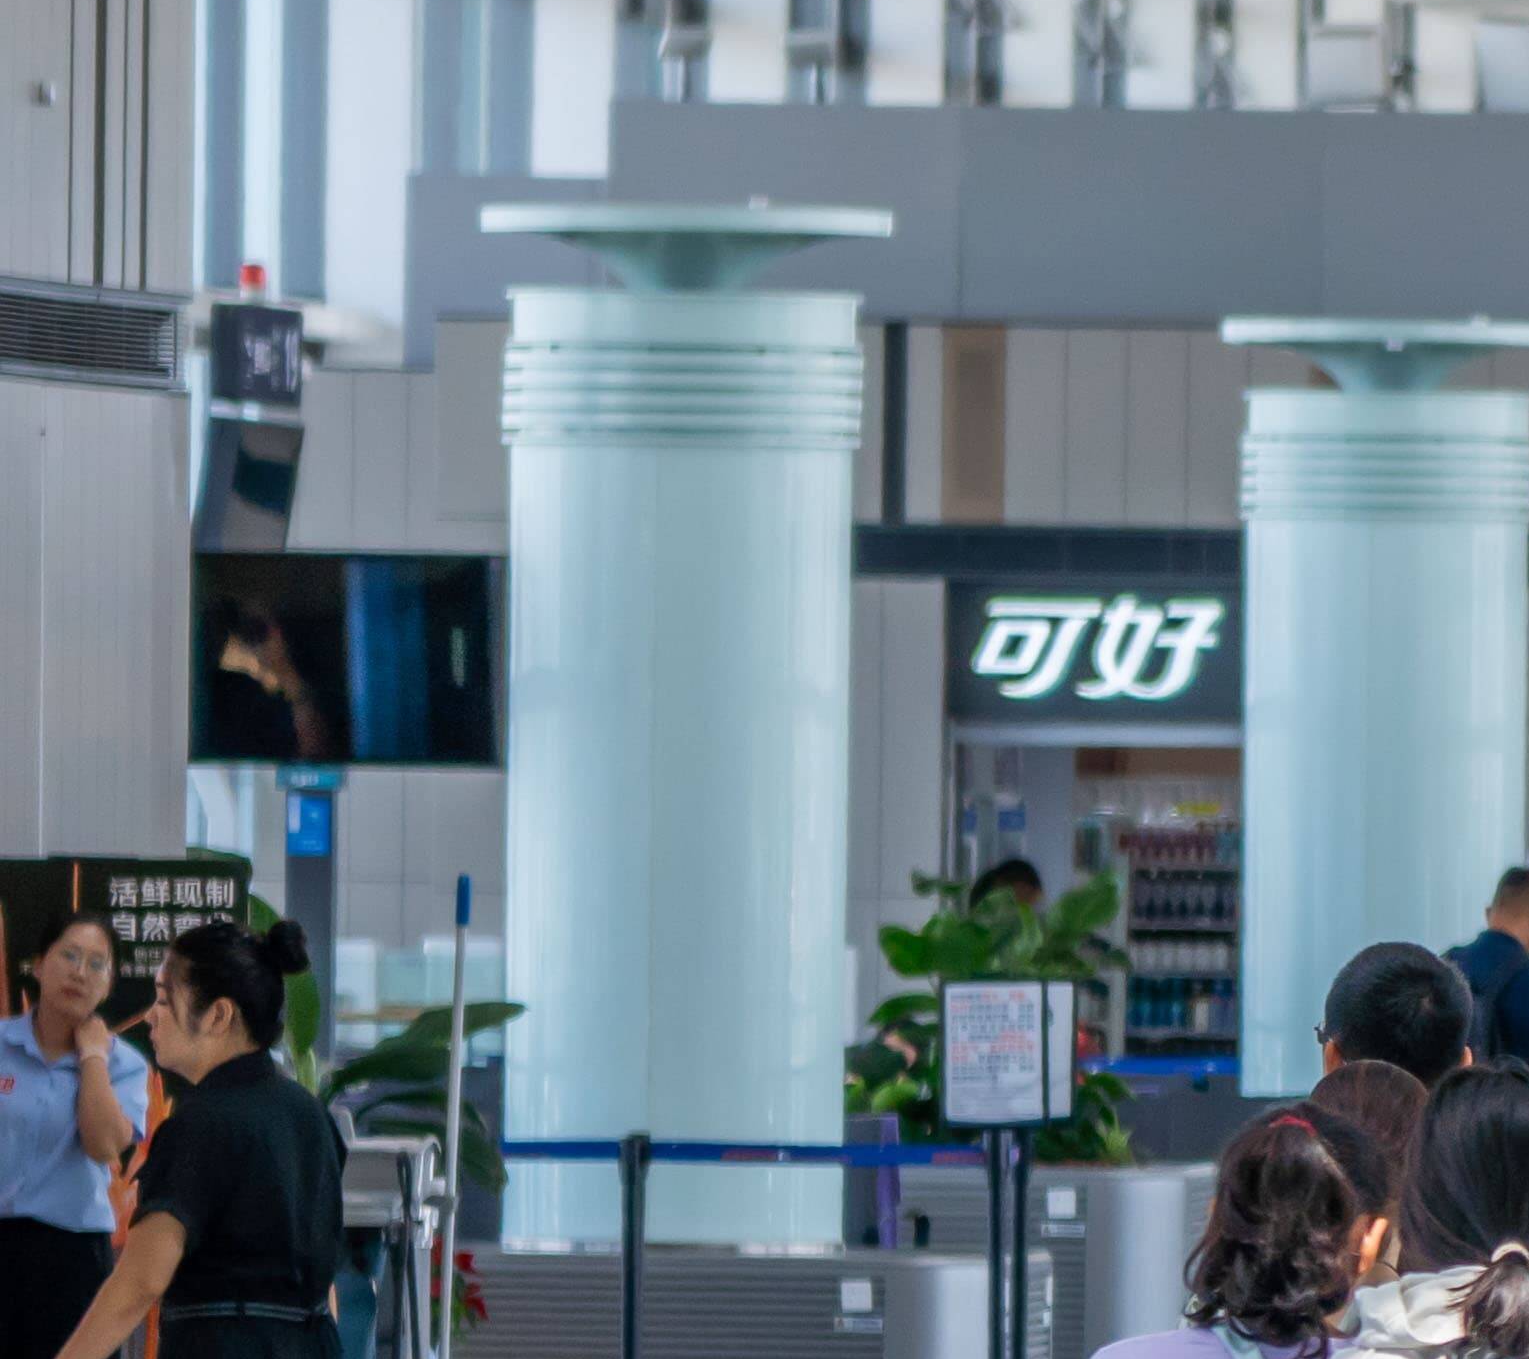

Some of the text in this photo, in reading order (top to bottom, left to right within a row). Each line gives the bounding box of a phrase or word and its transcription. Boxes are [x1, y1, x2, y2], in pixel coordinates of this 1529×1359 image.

[974, 596, 1223, 699] 可好
[110, 877, 234, 909] 活鲜现制
